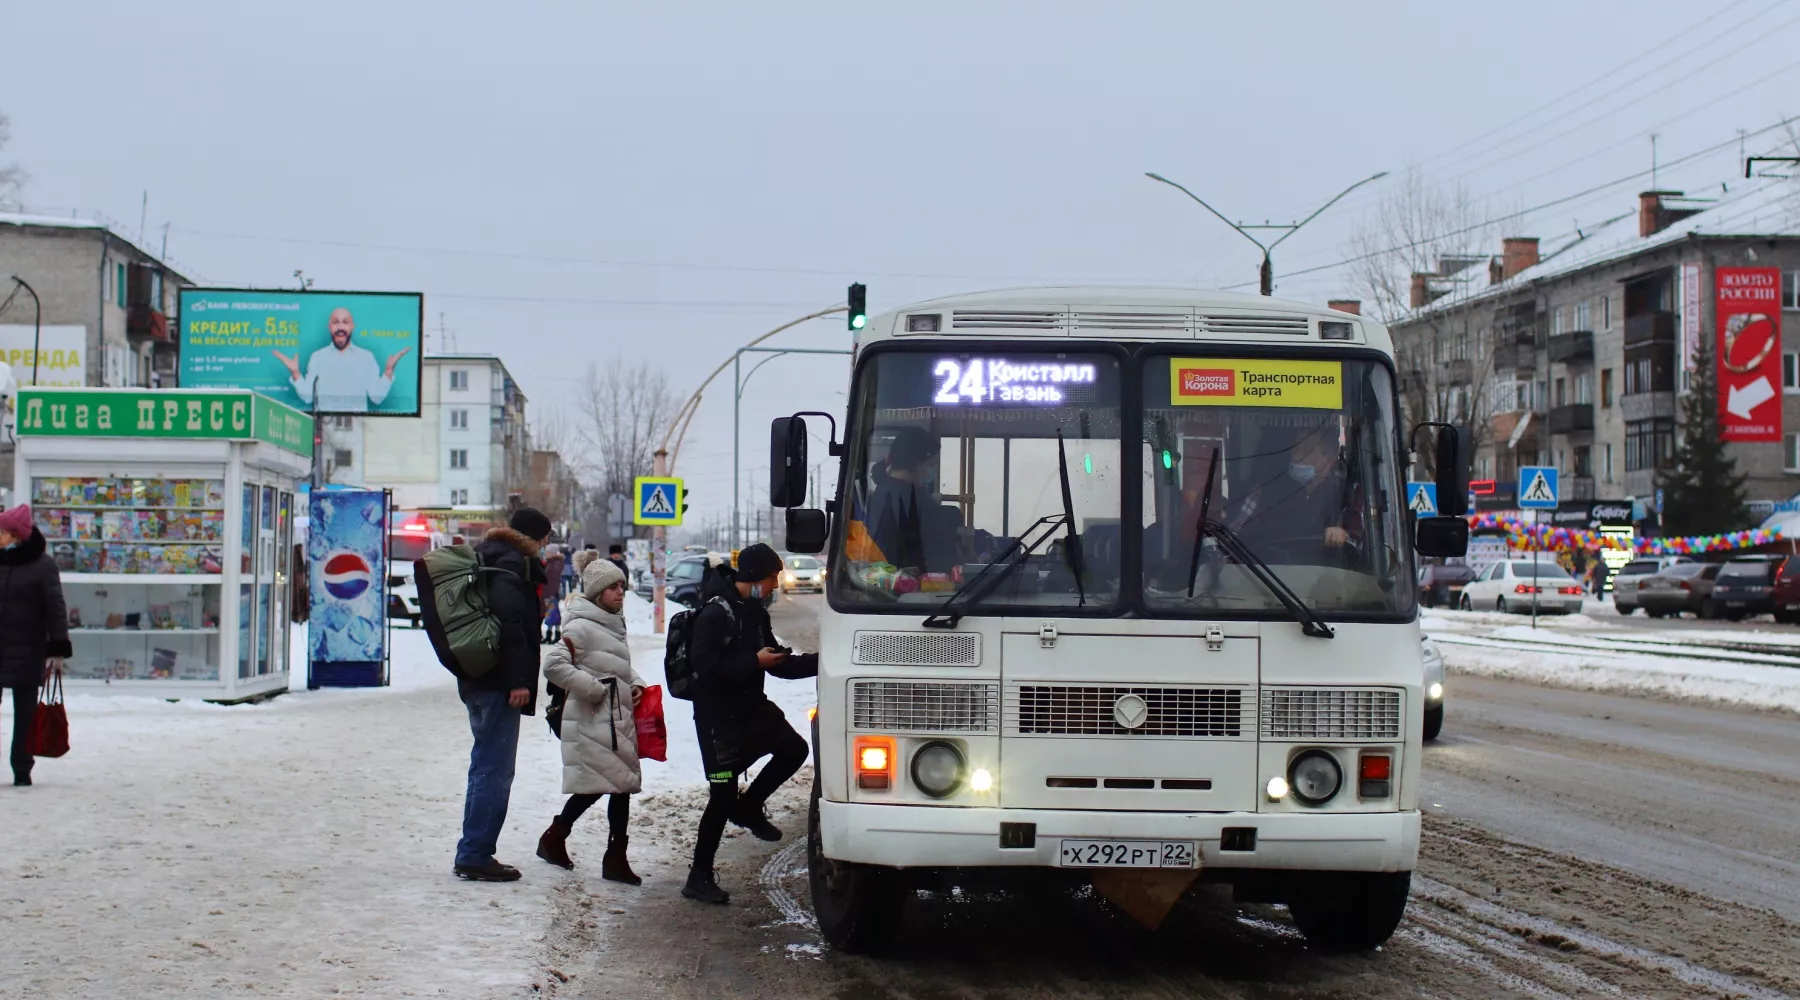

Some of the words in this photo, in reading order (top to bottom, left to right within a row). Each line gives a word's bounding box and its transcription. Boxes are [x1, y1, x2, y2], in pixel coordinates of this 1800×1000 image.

[1722, 274, 1774, 286] ЗОЛОТО
[1720, 288, 1775, 300] РОССИИ
[190, 321, 250, 335] КРЕДИТ
[988, 359, 1096, 383] Кристалл
[1194, 374, 1229, 382] Золотая
[1241, 371, 1335, 385] Транспортная
[934, 359, 987, 403] 24
[1184, 381, 1229, 391] Корона
[989, 381, 1062, 402] Гавань
[1243, 387, 1282, 398] карта
[23, 398, 112, 429] Лига
[137, 400, 246, 431] ПРЕСС
[1070, 844, 1157, 864] Х292РТ
[1163, 844, 1185, 859] 22
